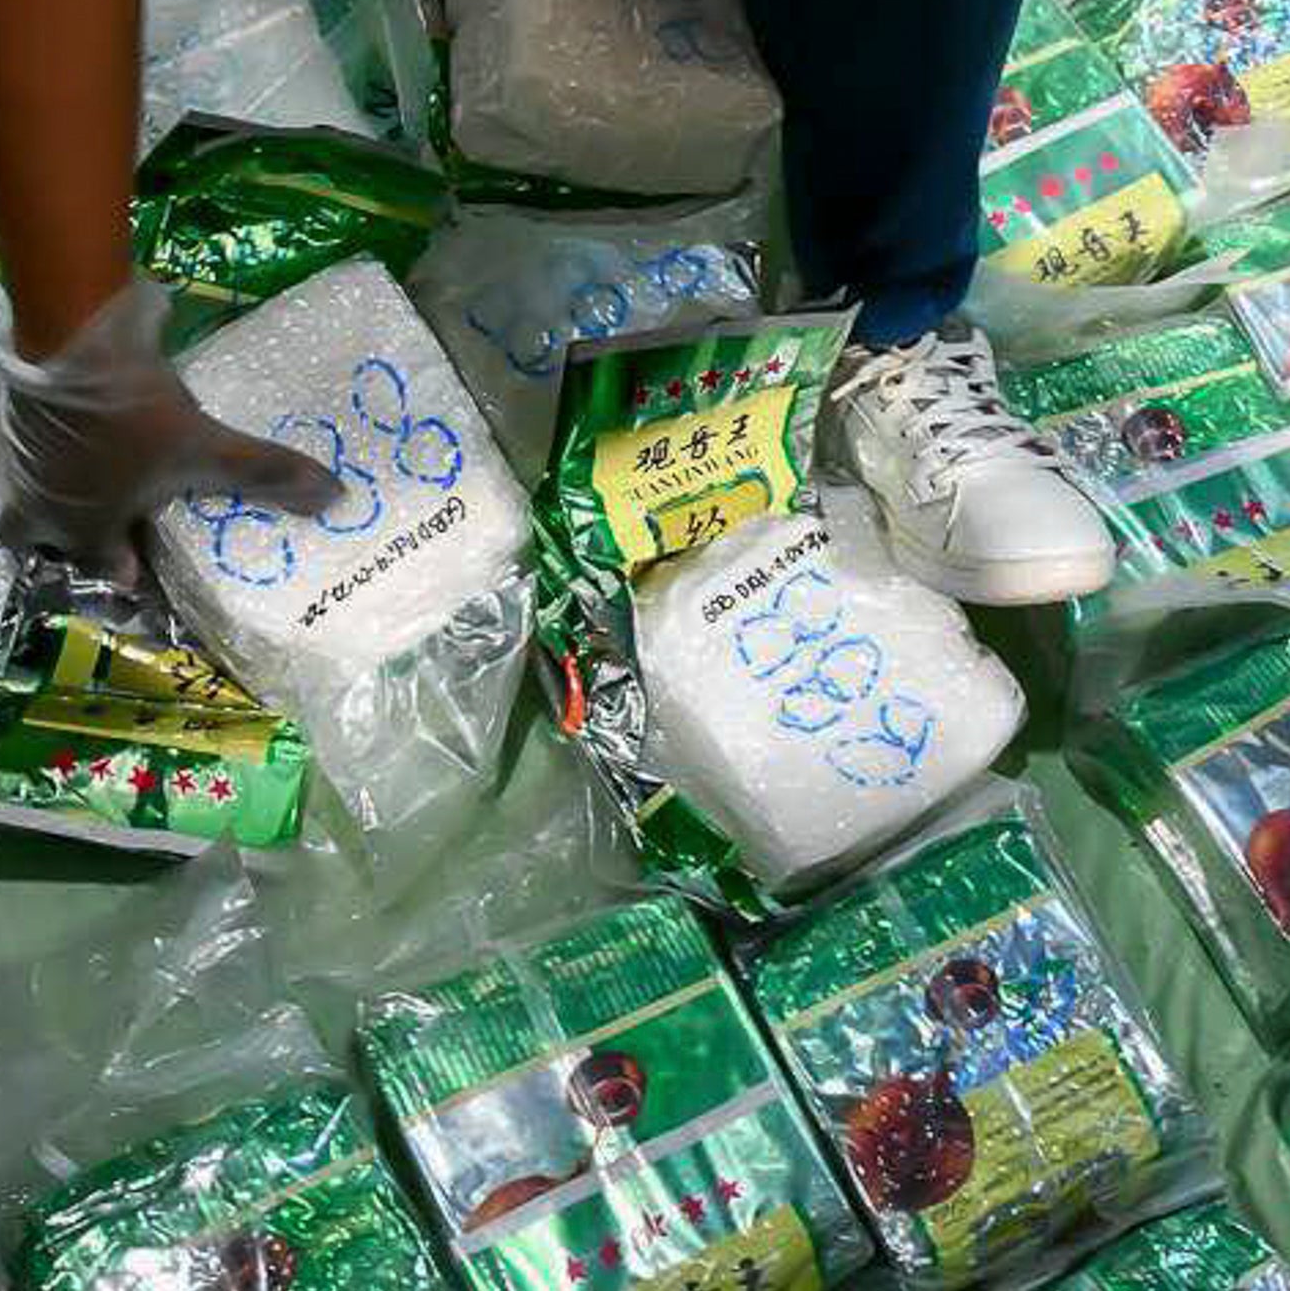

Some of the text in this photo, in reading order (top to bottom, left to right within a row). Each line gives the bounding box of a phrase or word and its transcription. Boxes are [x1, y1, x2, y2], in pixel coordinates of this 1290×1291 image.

[633, 413, 753, 473] 观音王
[731, 568, 937, 788] 888
